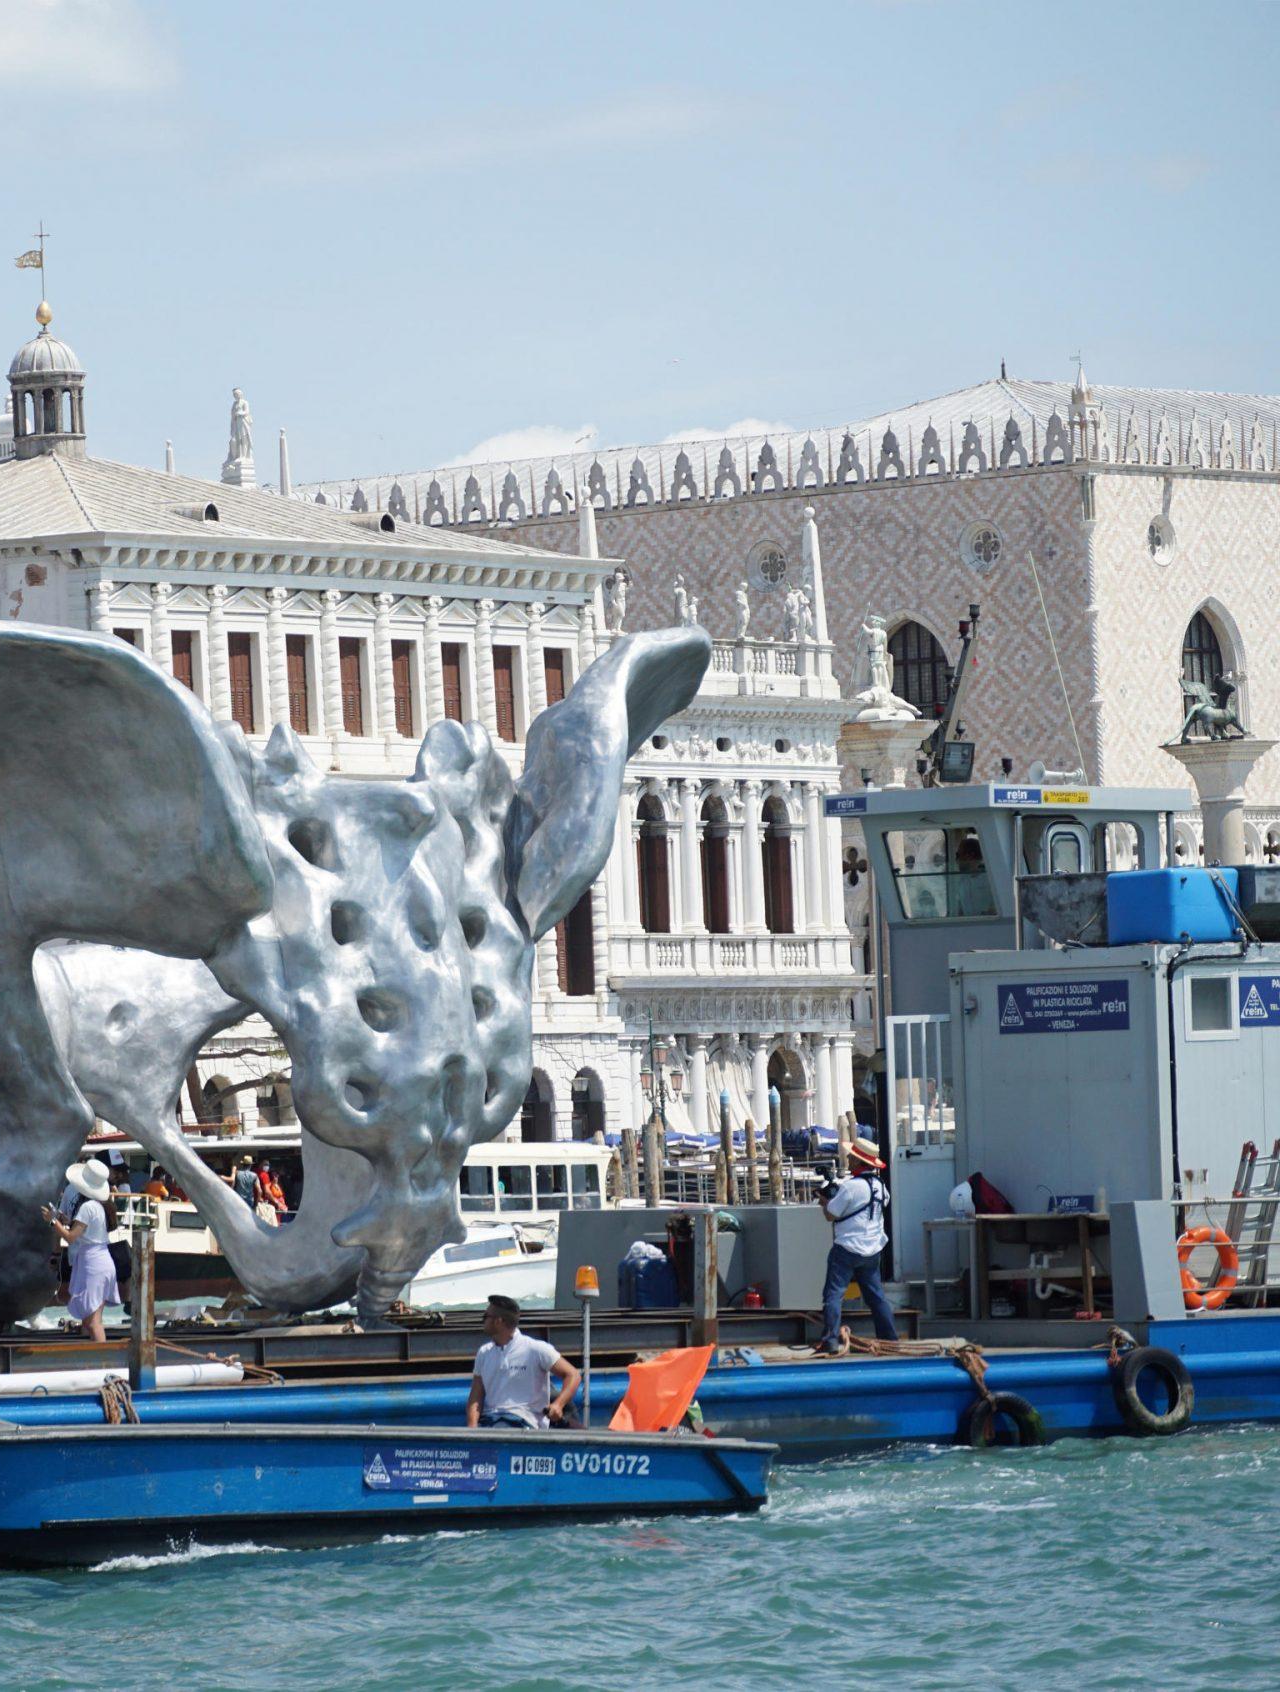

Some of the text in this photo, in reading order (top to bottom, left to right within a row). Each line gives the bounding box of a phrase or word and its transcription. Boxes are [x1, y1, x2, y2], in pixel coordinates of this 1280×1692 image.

[1026, 986, 1064, 996] PALIFICAZIONI
[1070, 984, 1098, 994] SOLUZIONI
[1032, 997, 1092, 1008] IN PLASTICA RICICLATA
[1052, 1020, 1075, 1029] VENEZIA
[561, 1452, 650, 1475] 6V01072
[420, 1480, 444, 1488] VENEZIA
